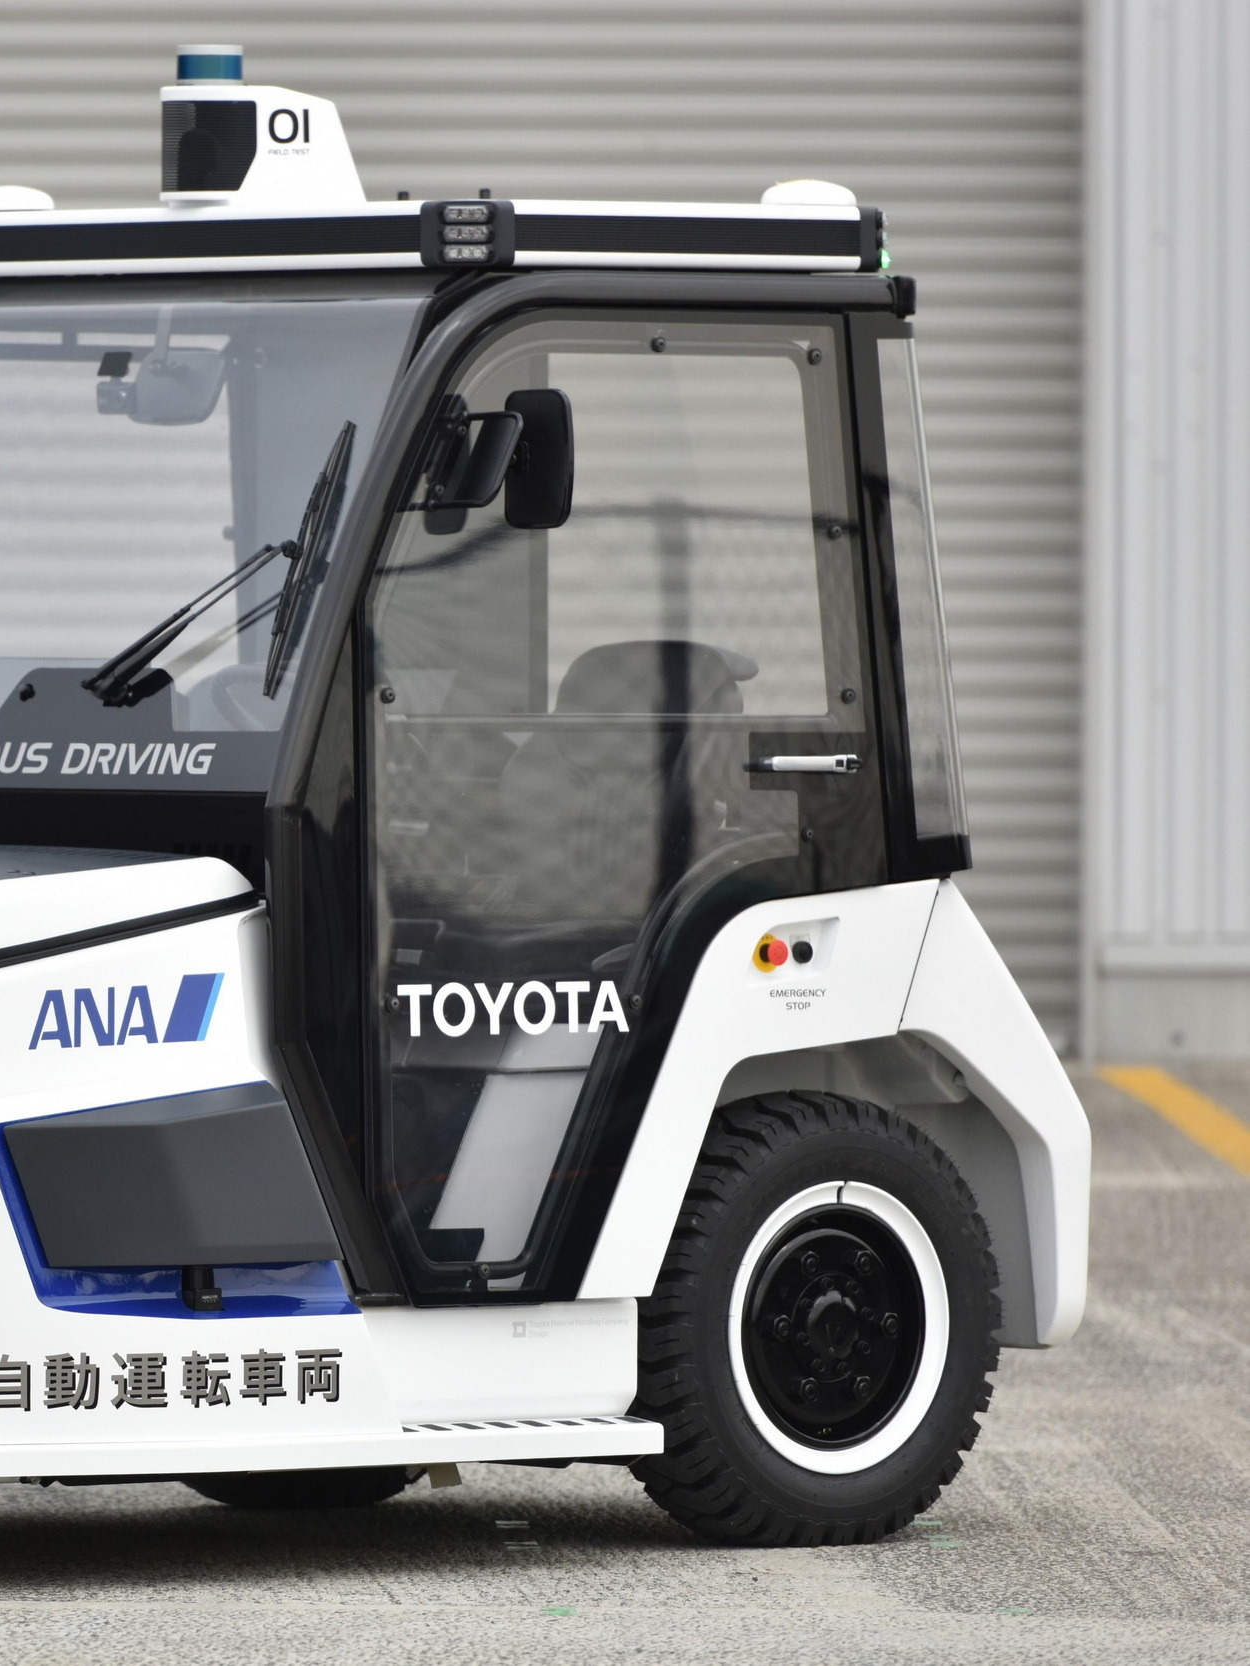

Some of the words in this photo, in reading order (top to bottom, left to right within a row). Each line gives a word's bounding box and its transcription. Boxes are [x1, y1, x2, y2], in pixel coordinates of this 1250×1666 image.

[60, 742, 217, 775] DRIVING
[769, 989, 826, 998] EMERGENCY
[397, 980, 630, 1037] TOYOTA
[785, 1001, 811, 1010] STOP
[28, 985, 159, 1051] ANA
[529, 1320, 550, 1328] Toyota
[551, 1319, 574, 1327] Material
[575, 1318, 601, 1327] Handling
[602, 1317, 629, 1326] Company
